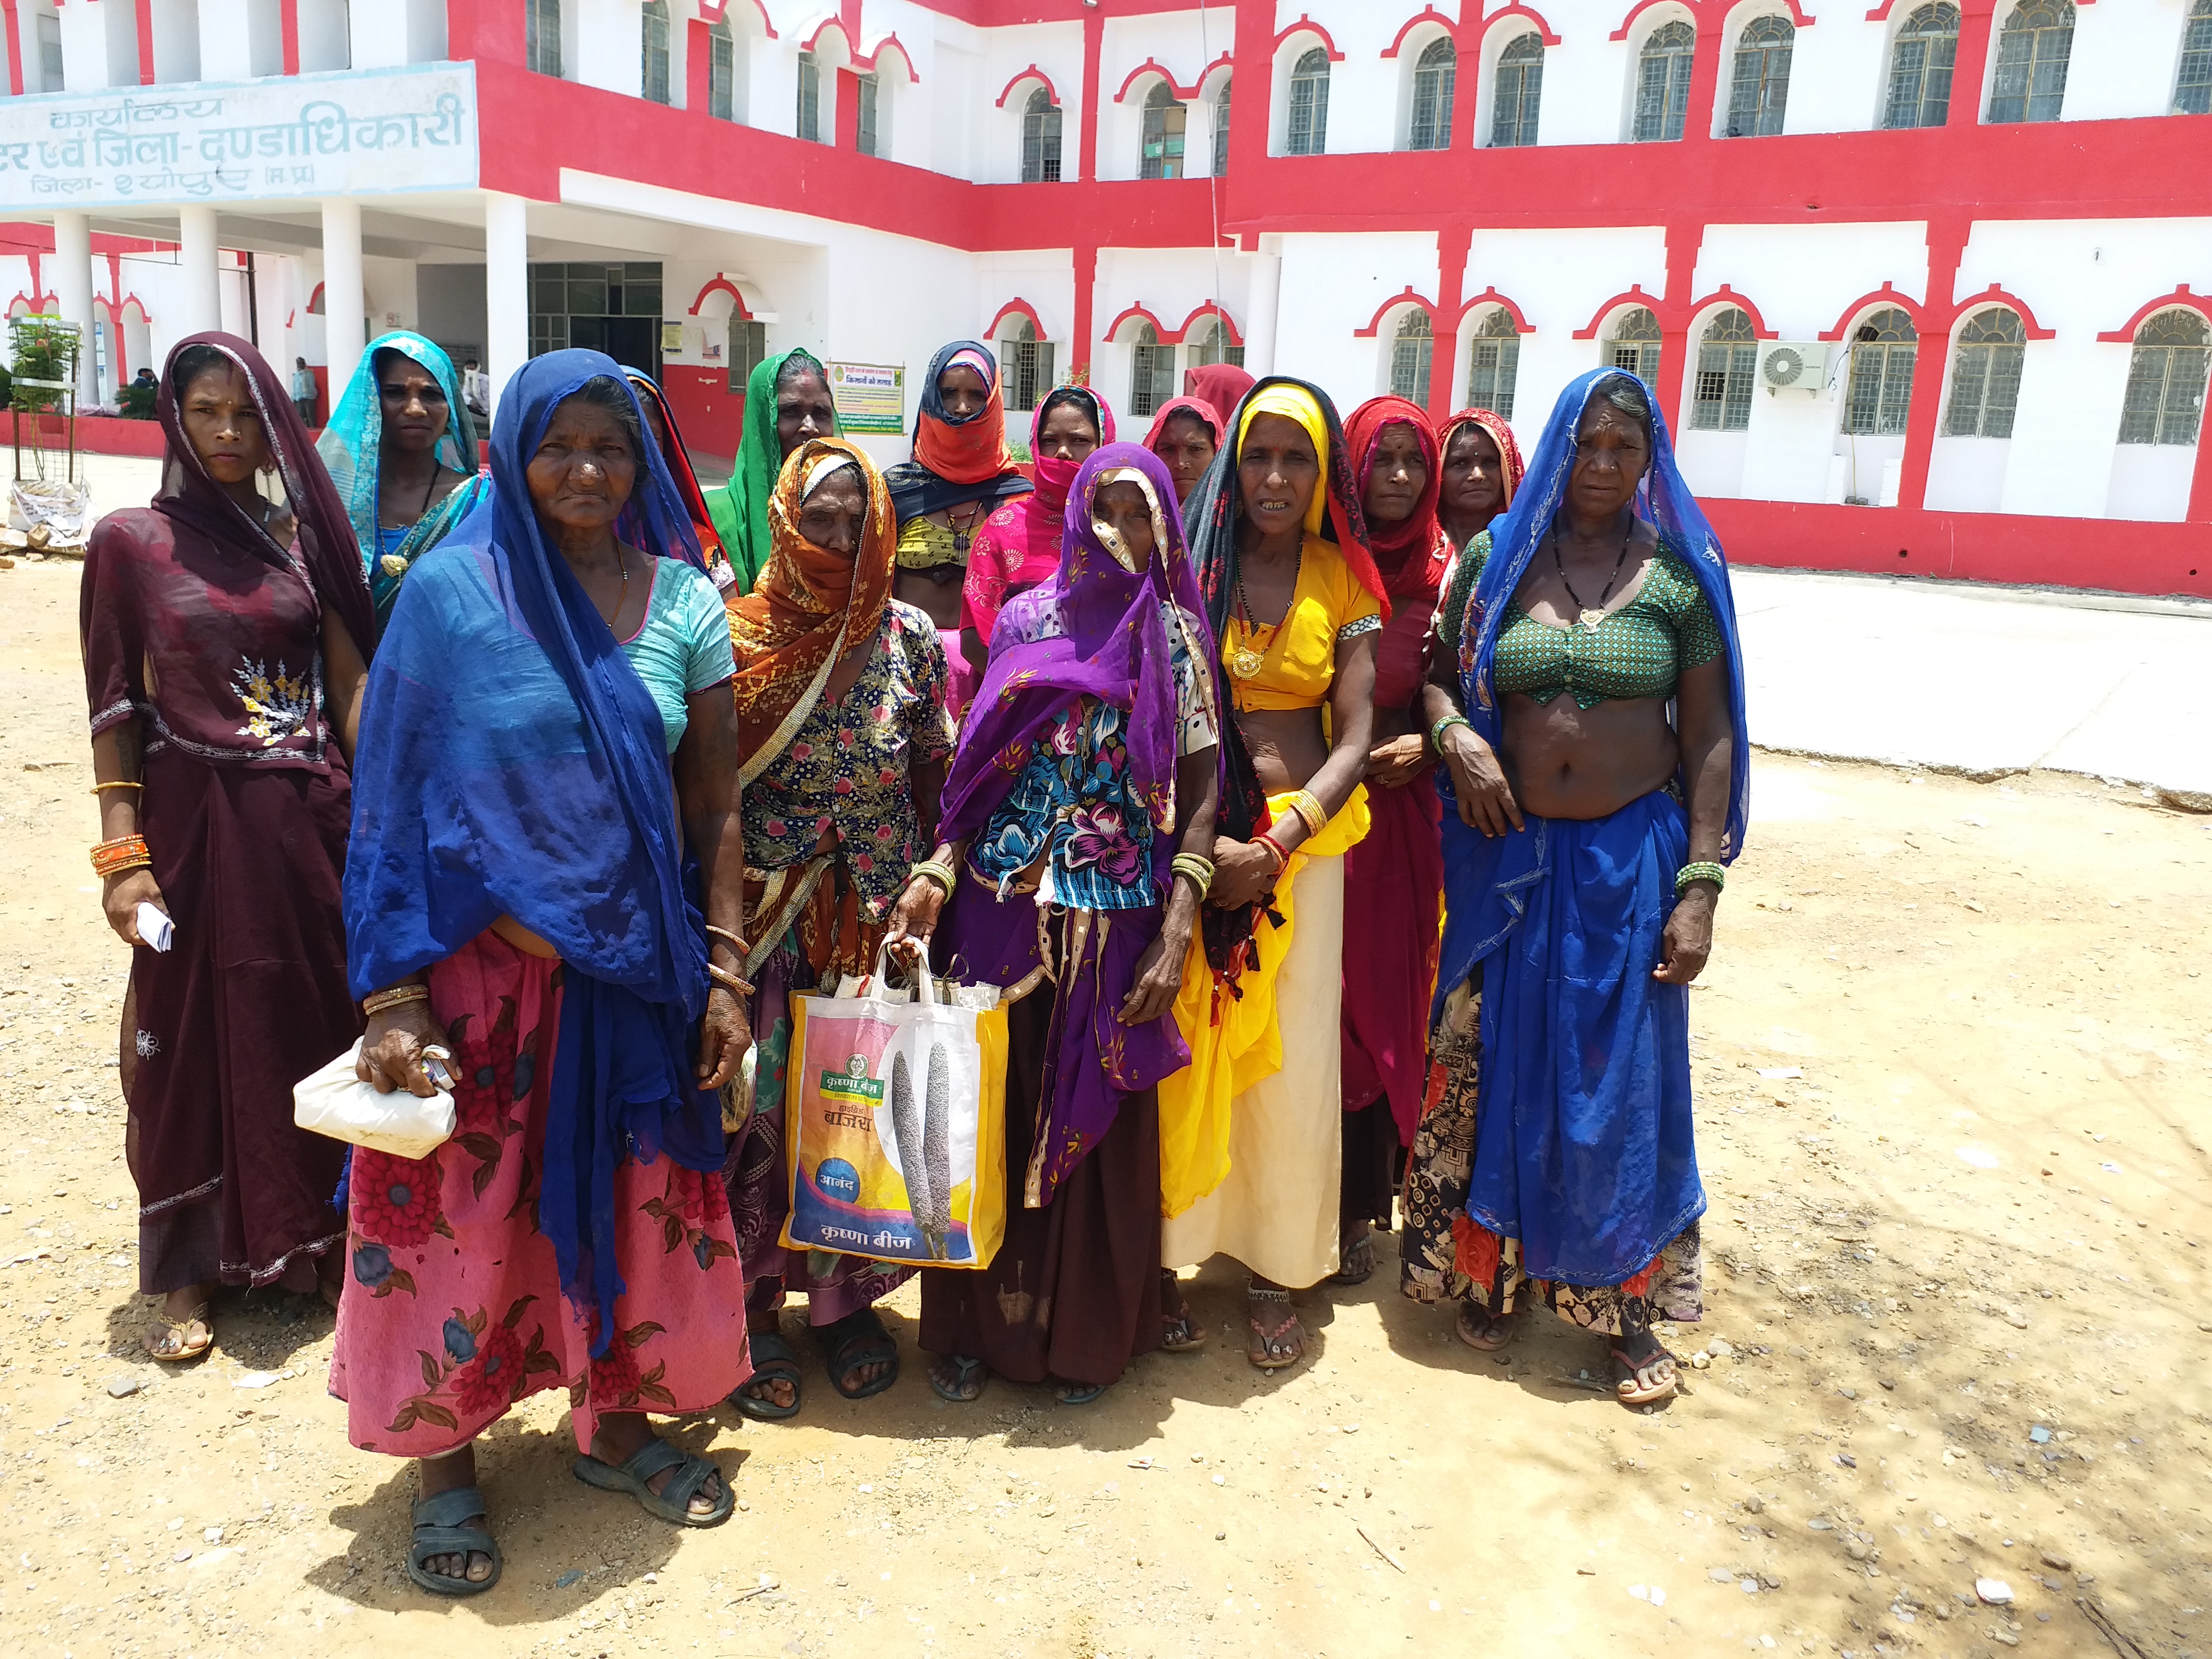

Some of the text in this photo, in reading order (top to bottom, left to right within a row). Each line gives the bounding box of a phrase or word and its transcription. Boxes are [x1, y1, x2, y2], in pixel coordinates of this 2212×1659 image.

[50, 98, 224, 129] कार्यालय
[36, 131, 87, 168] एवं
[827, 1076, 859, 1089] कृष्णा
[824, 1110, 873, 1132] बाजरा
[820, 1174, 854, 1191] आनंद
[820, 1224, 912, 1250] कृष्णा बीज
